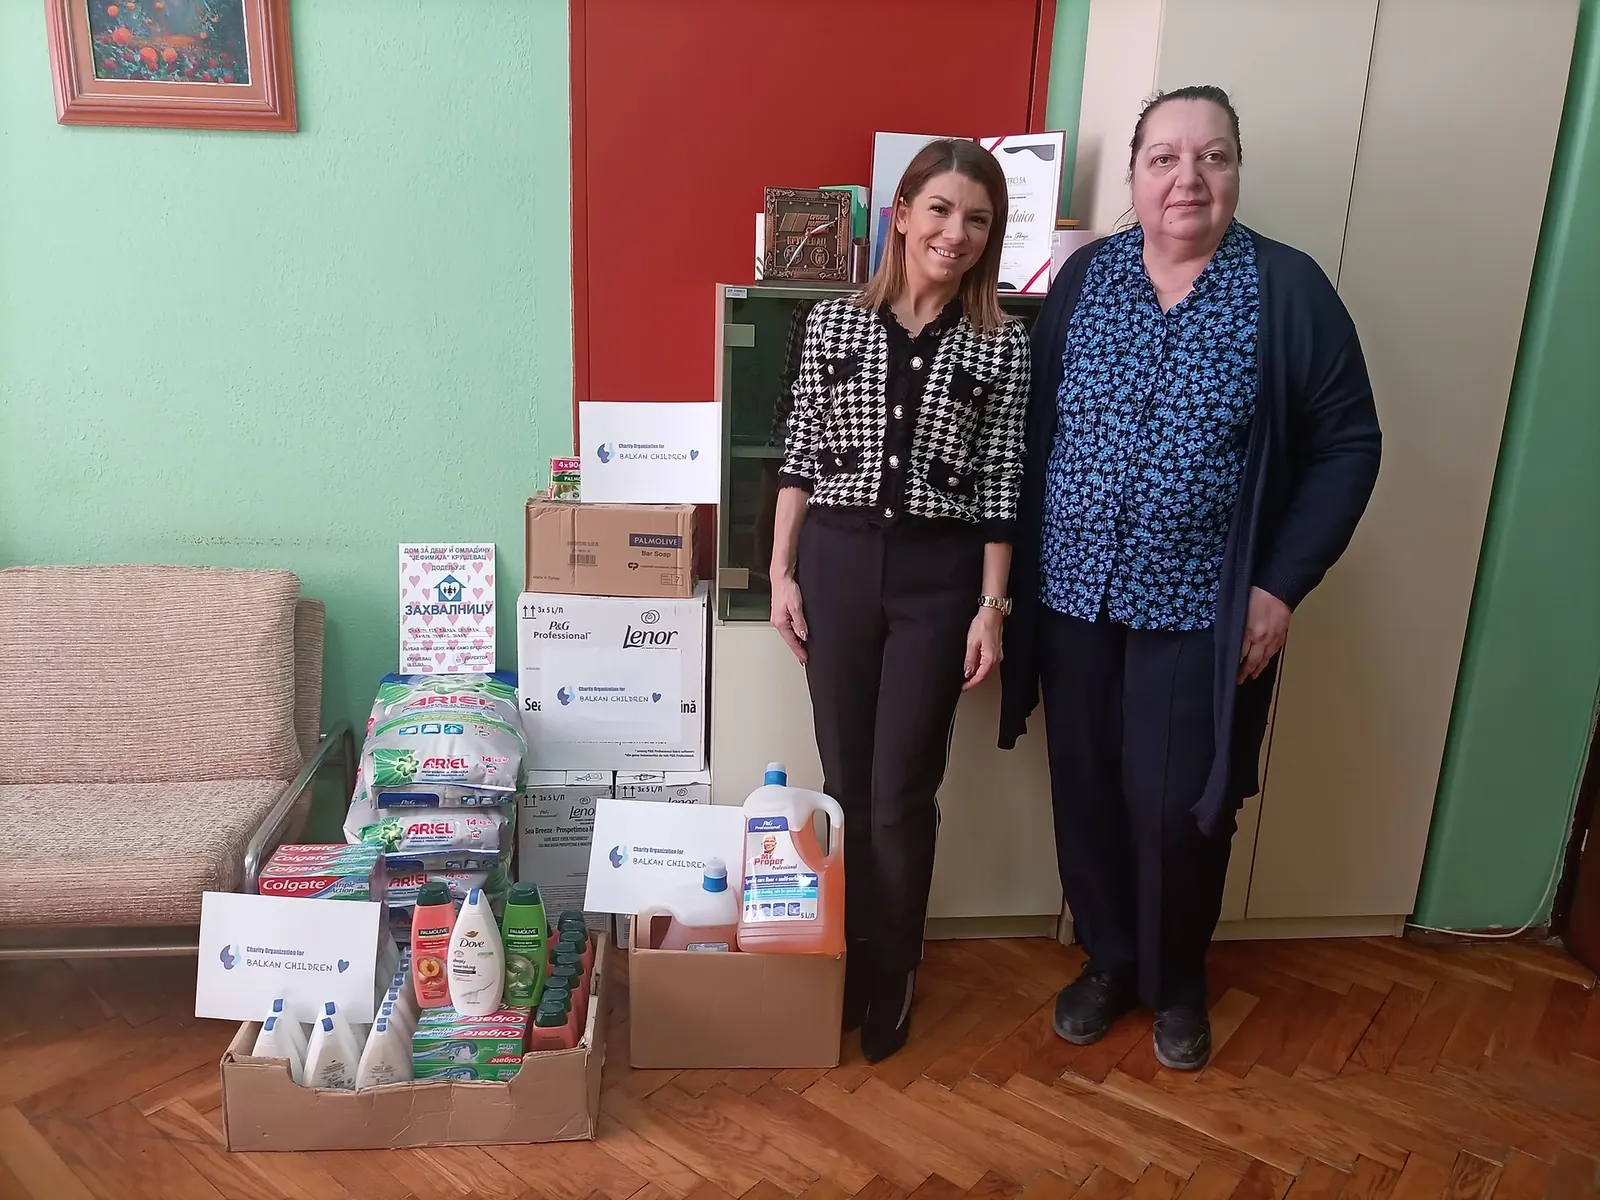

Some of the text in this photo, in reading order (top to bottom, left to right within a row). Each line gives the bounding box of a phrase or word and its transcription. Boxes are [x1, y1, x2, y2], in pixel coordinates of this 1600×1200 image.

[634, 537, 678, 546] PALMOLIVE
[404, 547, 419, 555] ДОМ
[430, 547, 448, 555] ДЕЦУ
[454, 547, 492, 555] ОМЛАДИНУ
[654, 550, 671, 558] Soap
[451, 554, 487, 562] КРУШЕВАЦ
[404, 604, 493, 617] ЗАХВАЛНИЦУ
[549, 620, 570, 631] P&G
[622, 625, 678, 649] Lenor
[403, 695, 496, 709] ARIEL
[579, 695, 649, 703] BALKAN CHILDREN
[680, 700, 697, 713] ină
[422, 758, 469, 769] ARIEL
[569, 806, 595, 819] Leno
[407, 823, 454, 835] ARIEL
[632, 846, 649, 854] Charity
[649, 847, 676, 855] Organization
[632, 857, 707, 869] BALKAN CHILDREN
[754, 858, 784, 867] Proper
[334, 881, 355, 889] Triple
[388, 873, 430, 887] ARIEL
[262, 880, 327, 892] Colgate
[420, 927, 448, 935] PALMOLIVE
[459, 938, 485, 948] Dove
[246, 946, 264, 954] Charity
[264, 947, 297, 956] Organization
[246, 958, 333, 972] BALKAN CHILDREN
[467, 1015, 525, 1023] Colgate
[463, 1029, 520, 1038] Colgate
[490, 1056, 522, 1064] Colgate
